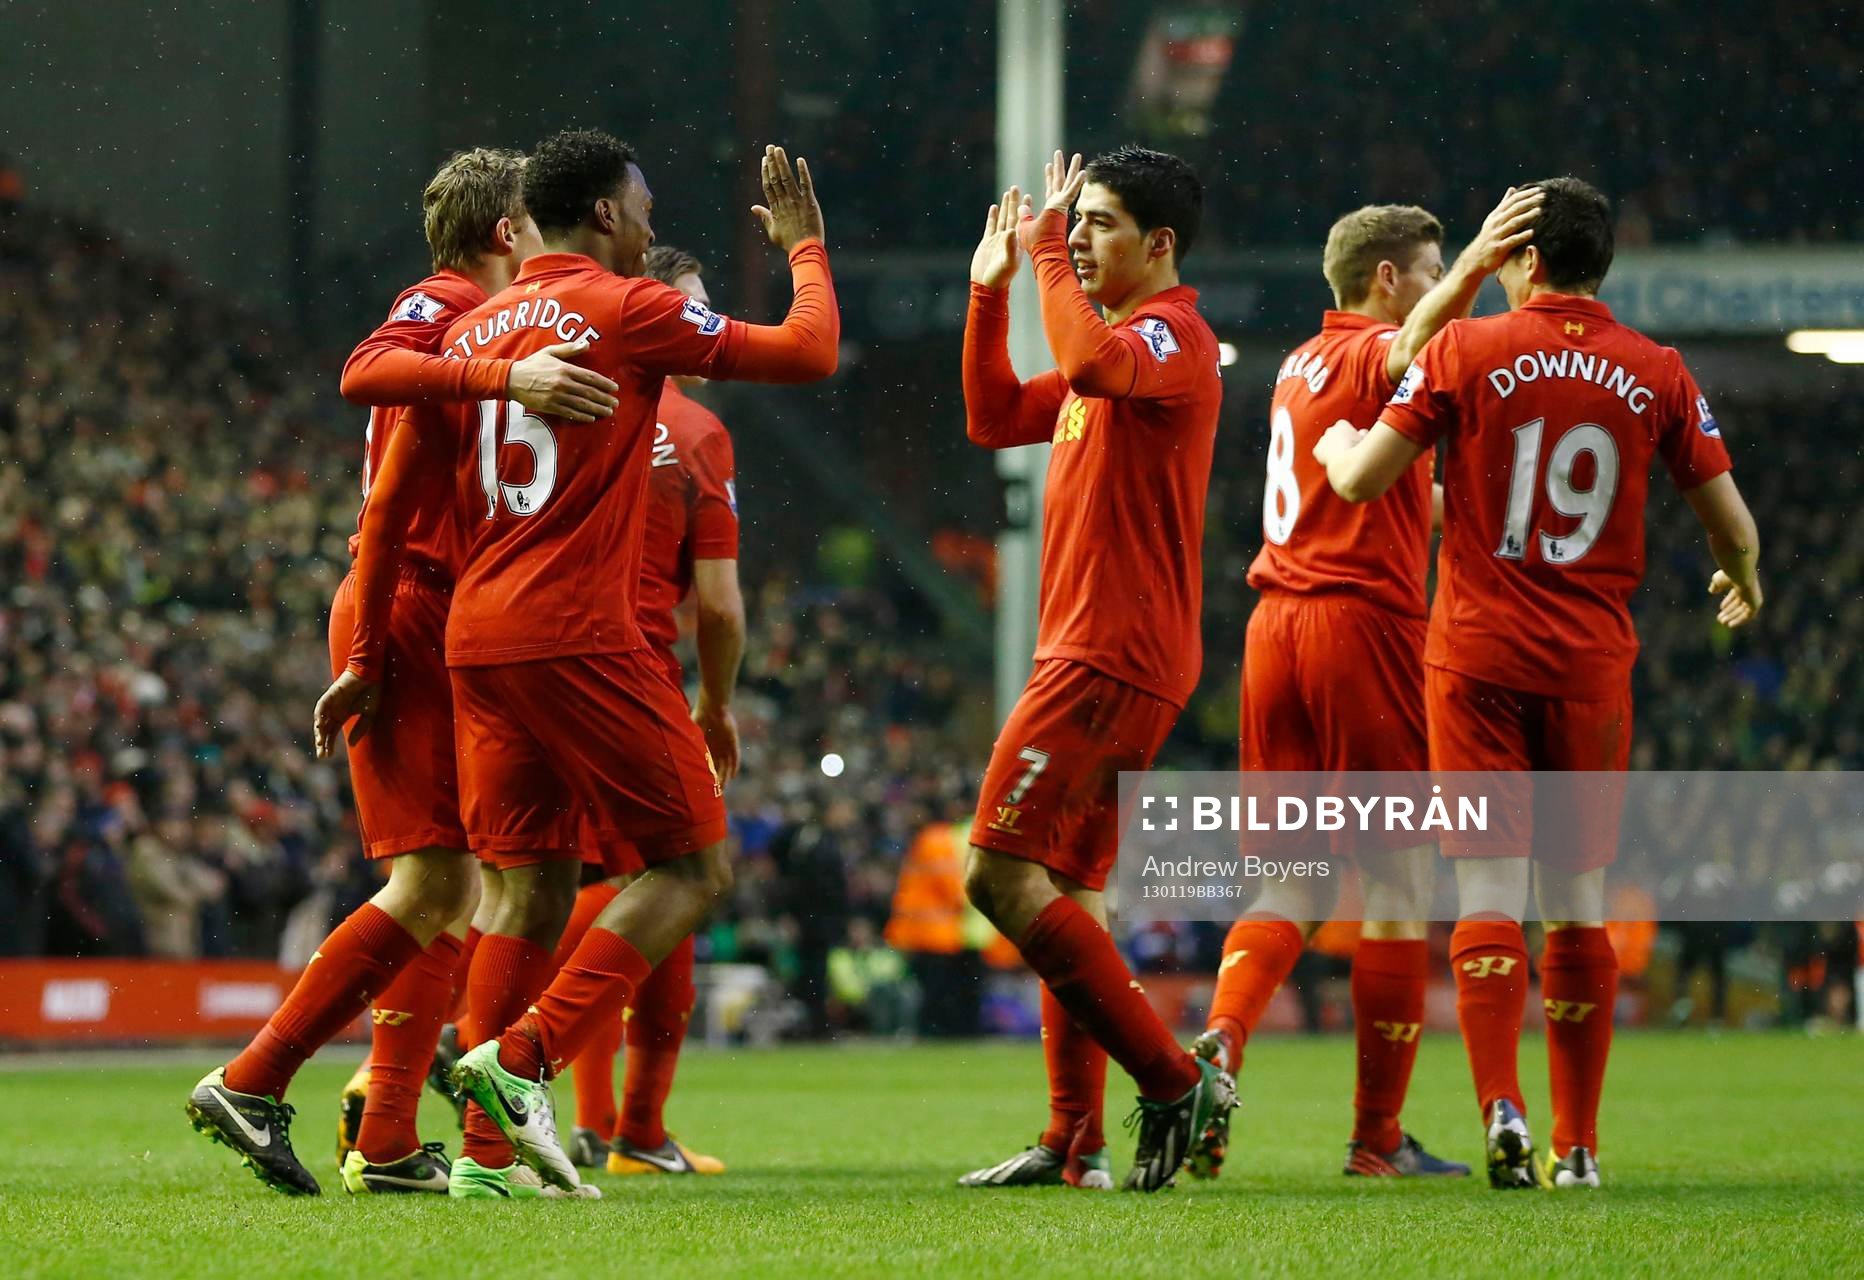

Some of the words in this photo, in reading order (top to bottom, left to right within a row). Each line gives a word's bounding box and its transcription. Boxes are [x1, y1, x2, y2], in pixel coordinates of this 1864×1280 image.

[1487, 349, 1655, 415] DOWNING
[477, 399, 558, 520] 15
[1262, 405, 1301, 546] 8
[1493, 417, 1620, 564] 19
[1004, 746, 1050, 805] 7
